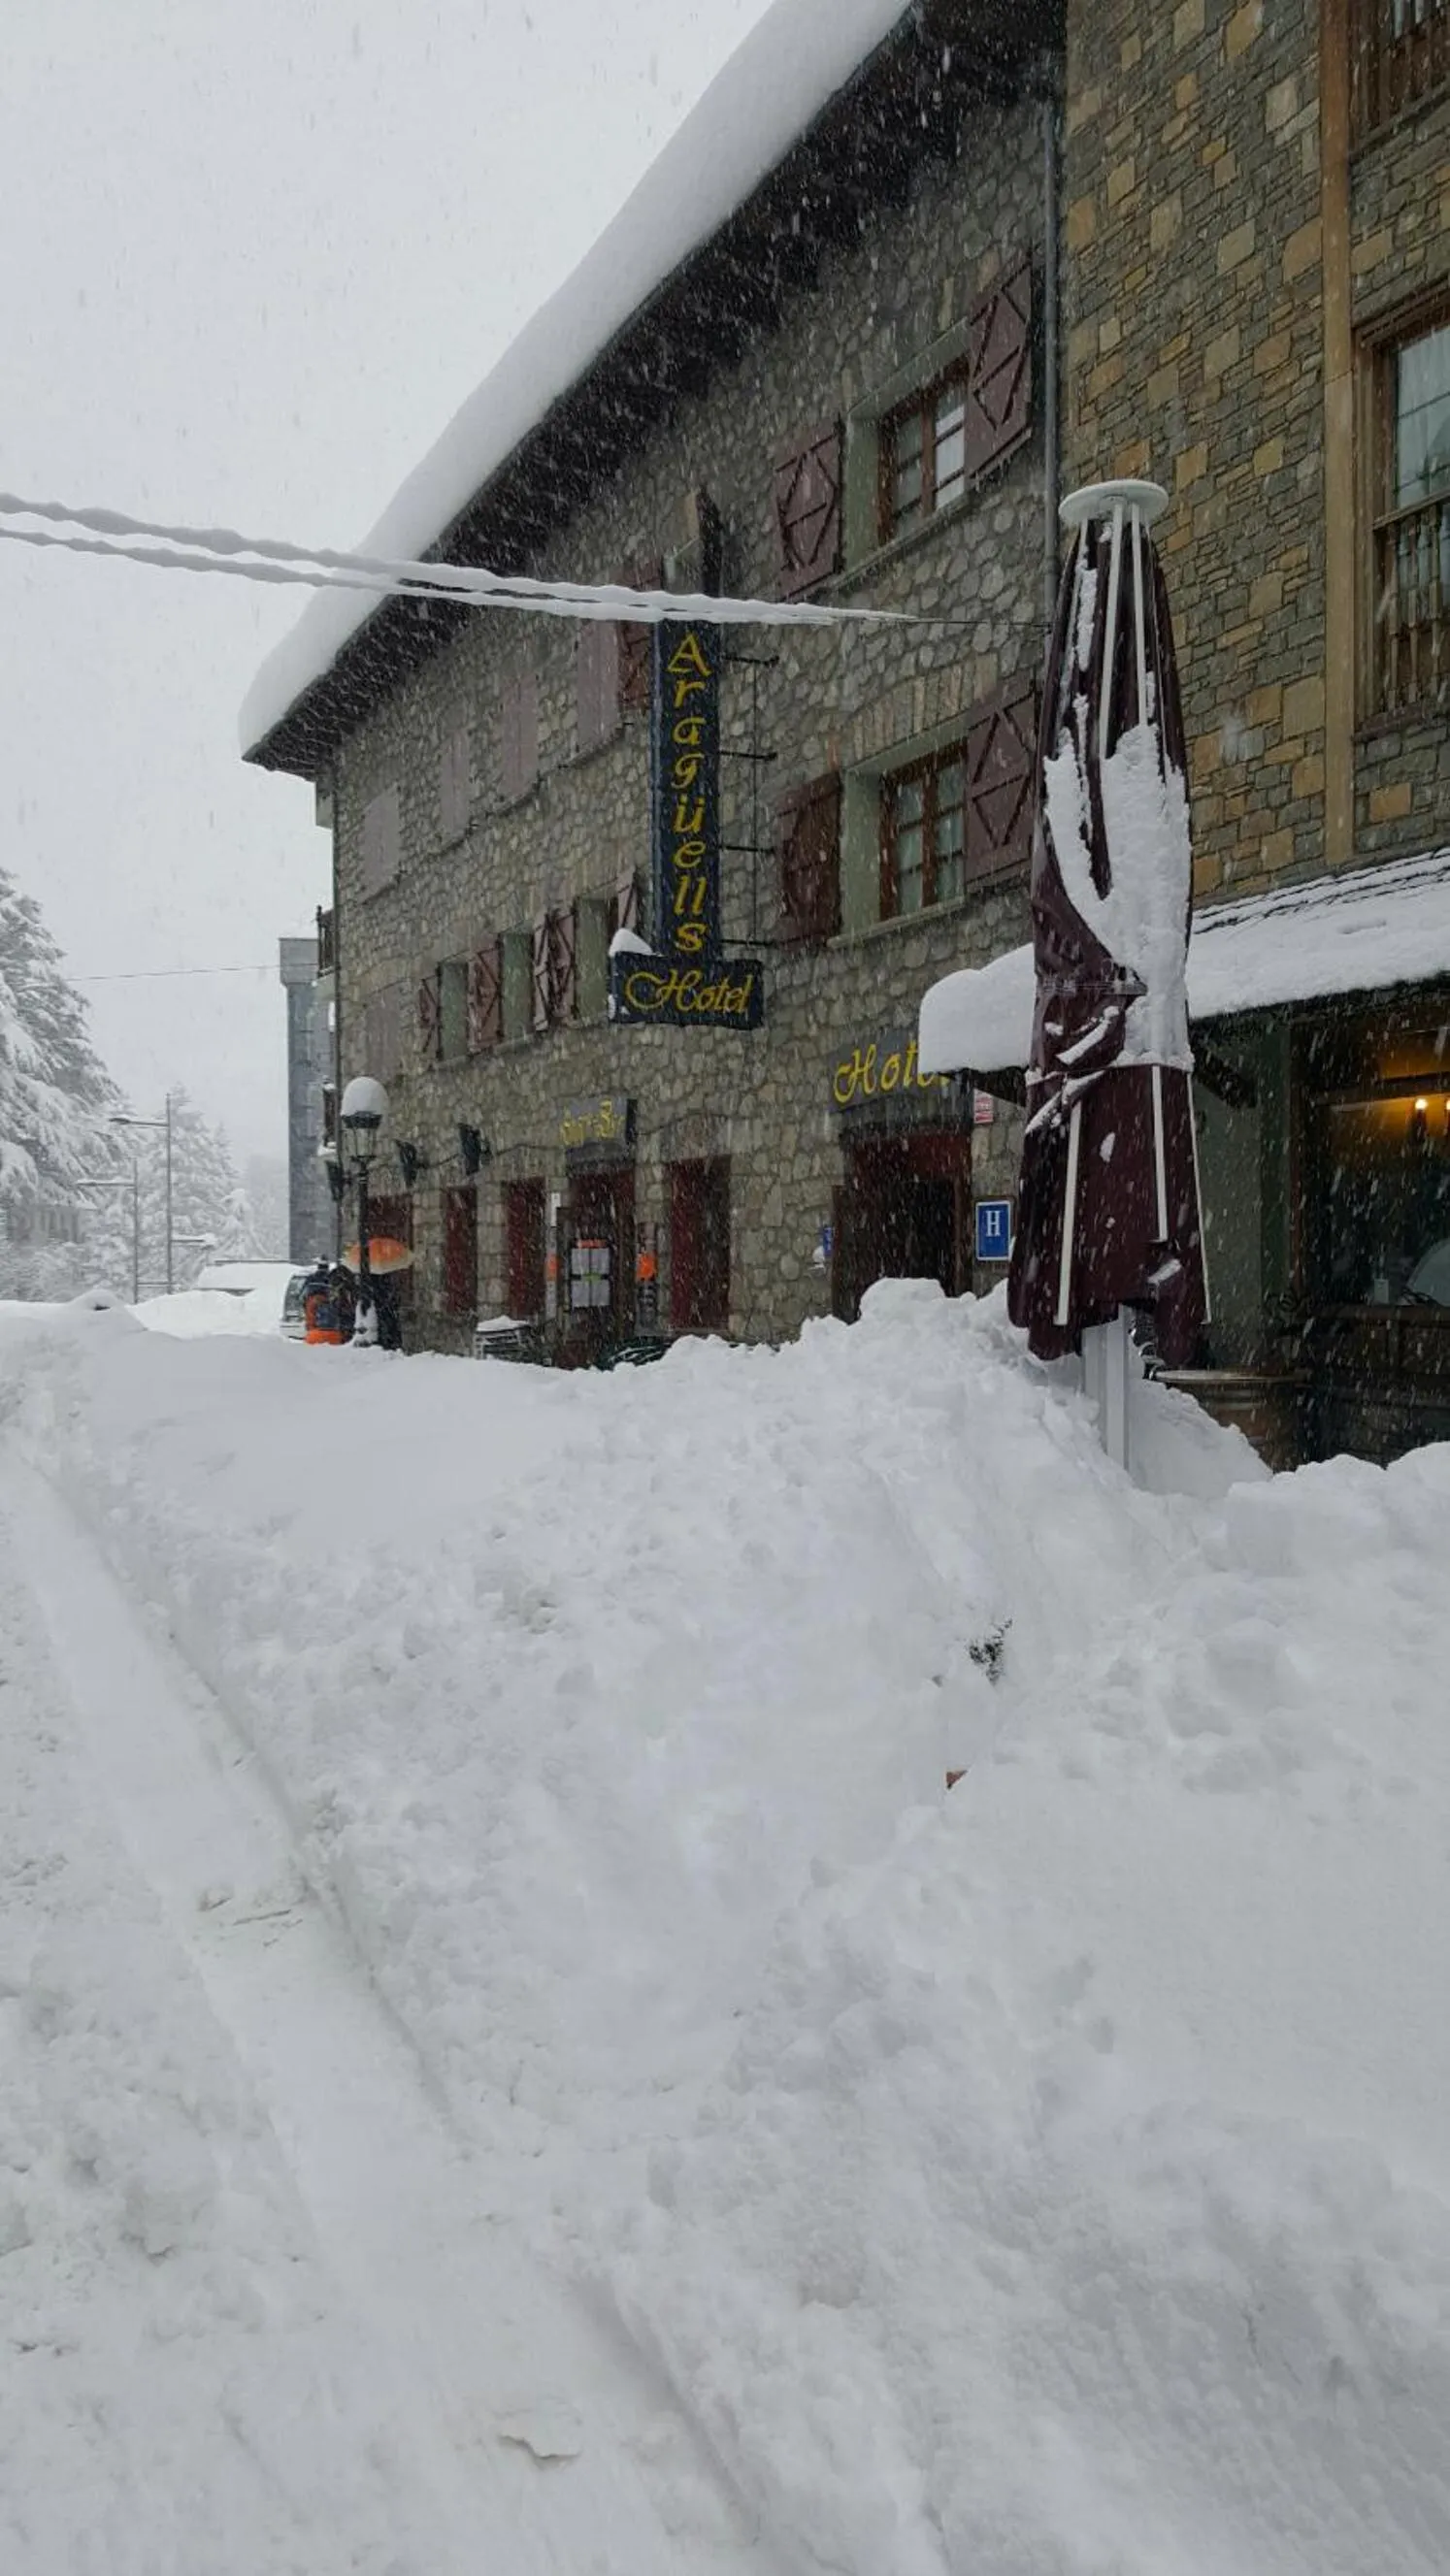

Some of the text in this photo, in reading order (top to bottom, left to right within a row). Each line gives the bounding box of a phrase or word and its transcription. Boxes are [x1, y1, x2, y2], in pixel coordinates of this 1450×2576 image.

[667, 633, 712, 953] Aragüells
[625, 968, 753, 1014] Hotel
[834, 1040, 950, 1103] Hot
[986, 1210, 1001, 1237] H
